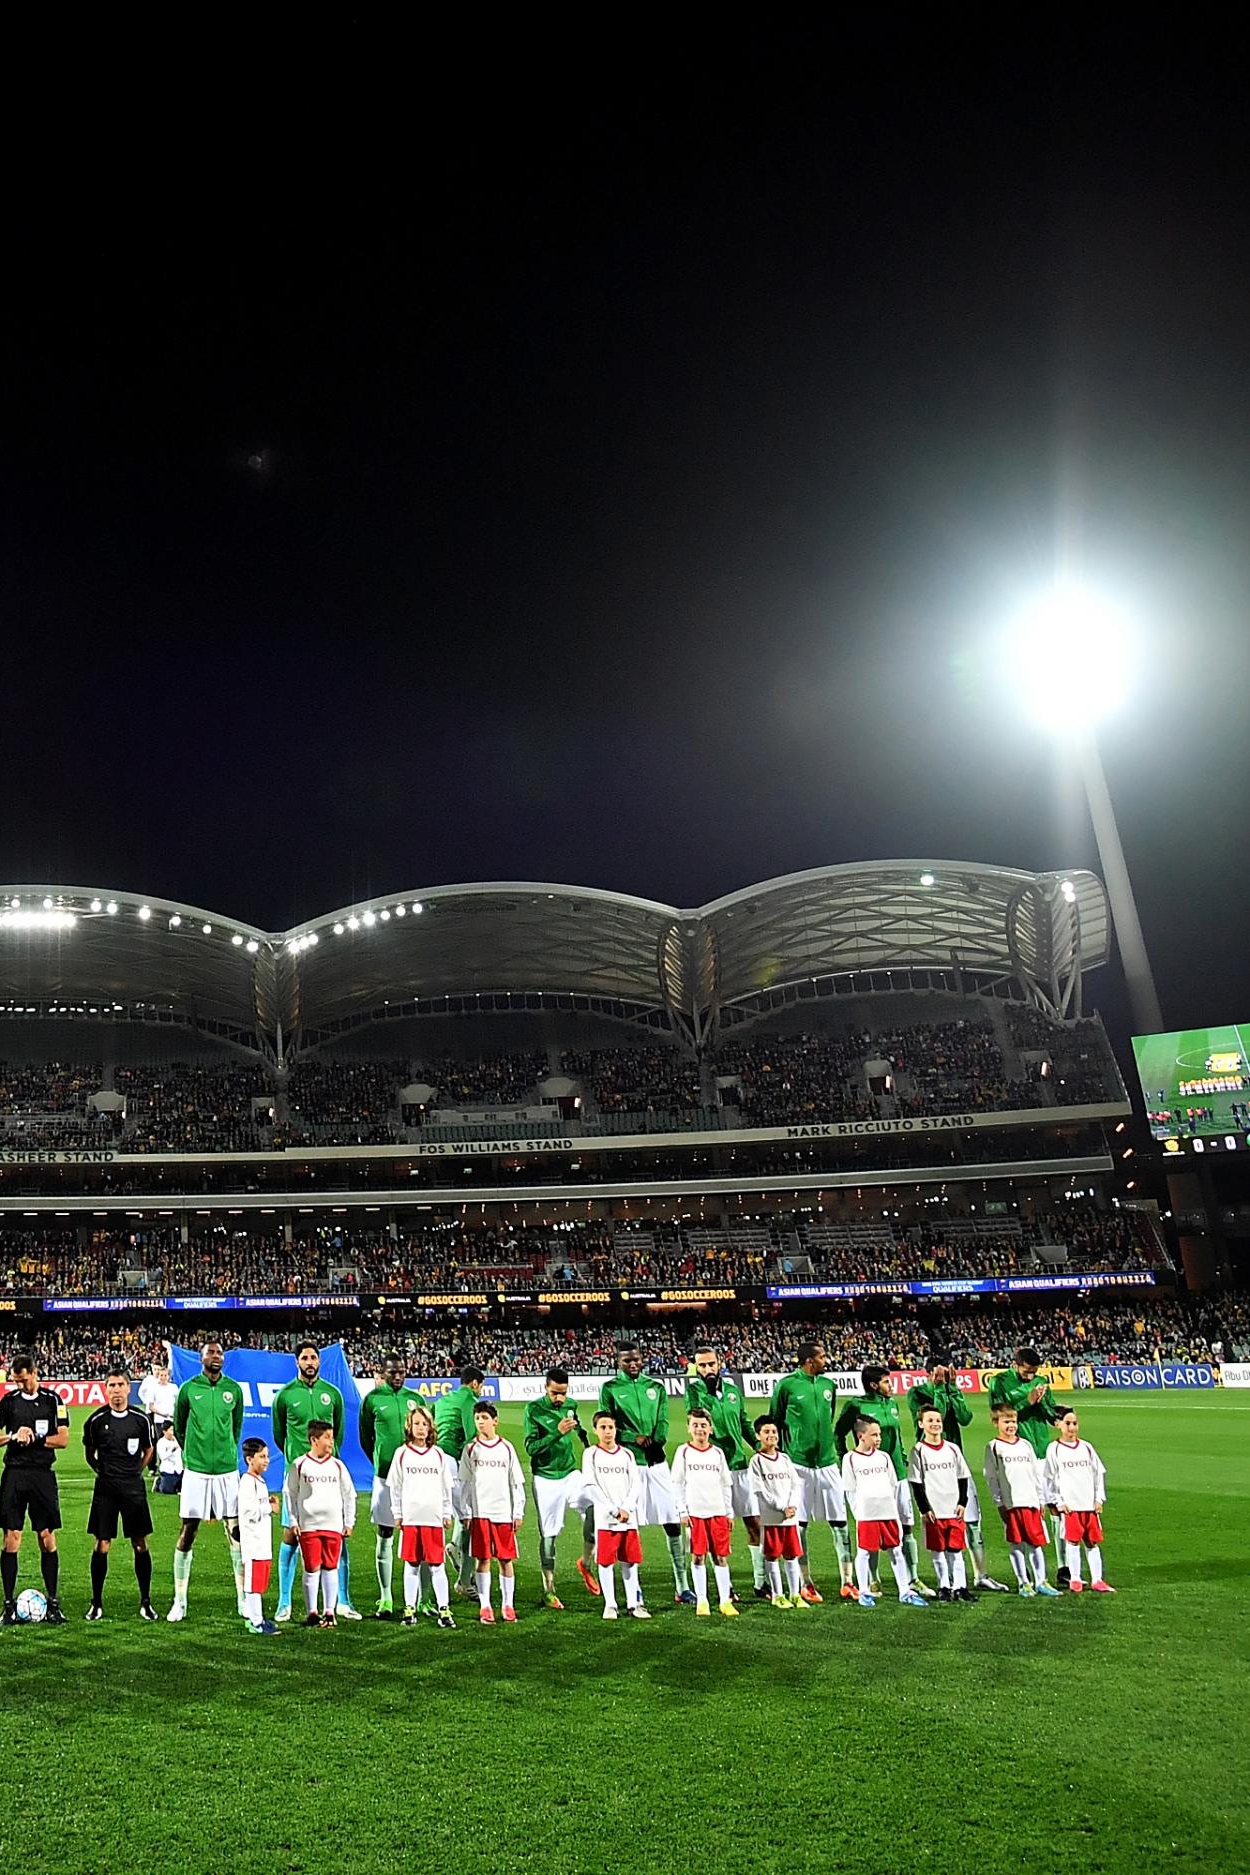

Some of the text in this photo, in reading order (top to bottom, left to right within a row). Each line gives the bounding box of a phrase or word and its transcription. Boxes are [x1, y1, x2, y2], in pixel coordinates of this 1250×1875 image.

[787, 1115, 974, 1138] MARK RICCIUTO STAND
[419, 1139, 573, 1154] FOS WILLIAMS STAND
[64, 1151, 114, 1162] STAND
[418, 1295, 487, 1305] #GOSOCCEROOS
[538, 1292, 611, 1303] #GOSOCCEROOS
[661, 1289, 736, 1300] #GOSOCCEROOS
[1094, 1368, 1210, 1386] SAISON CARD
[750, 1379, 769, 1392] ONE
[474, 1459, 506, 1468] TOYOTA
[406, 1467, 438, 1475] TOYOTA
[303, 1475, 337, 1484] TOYOTA
